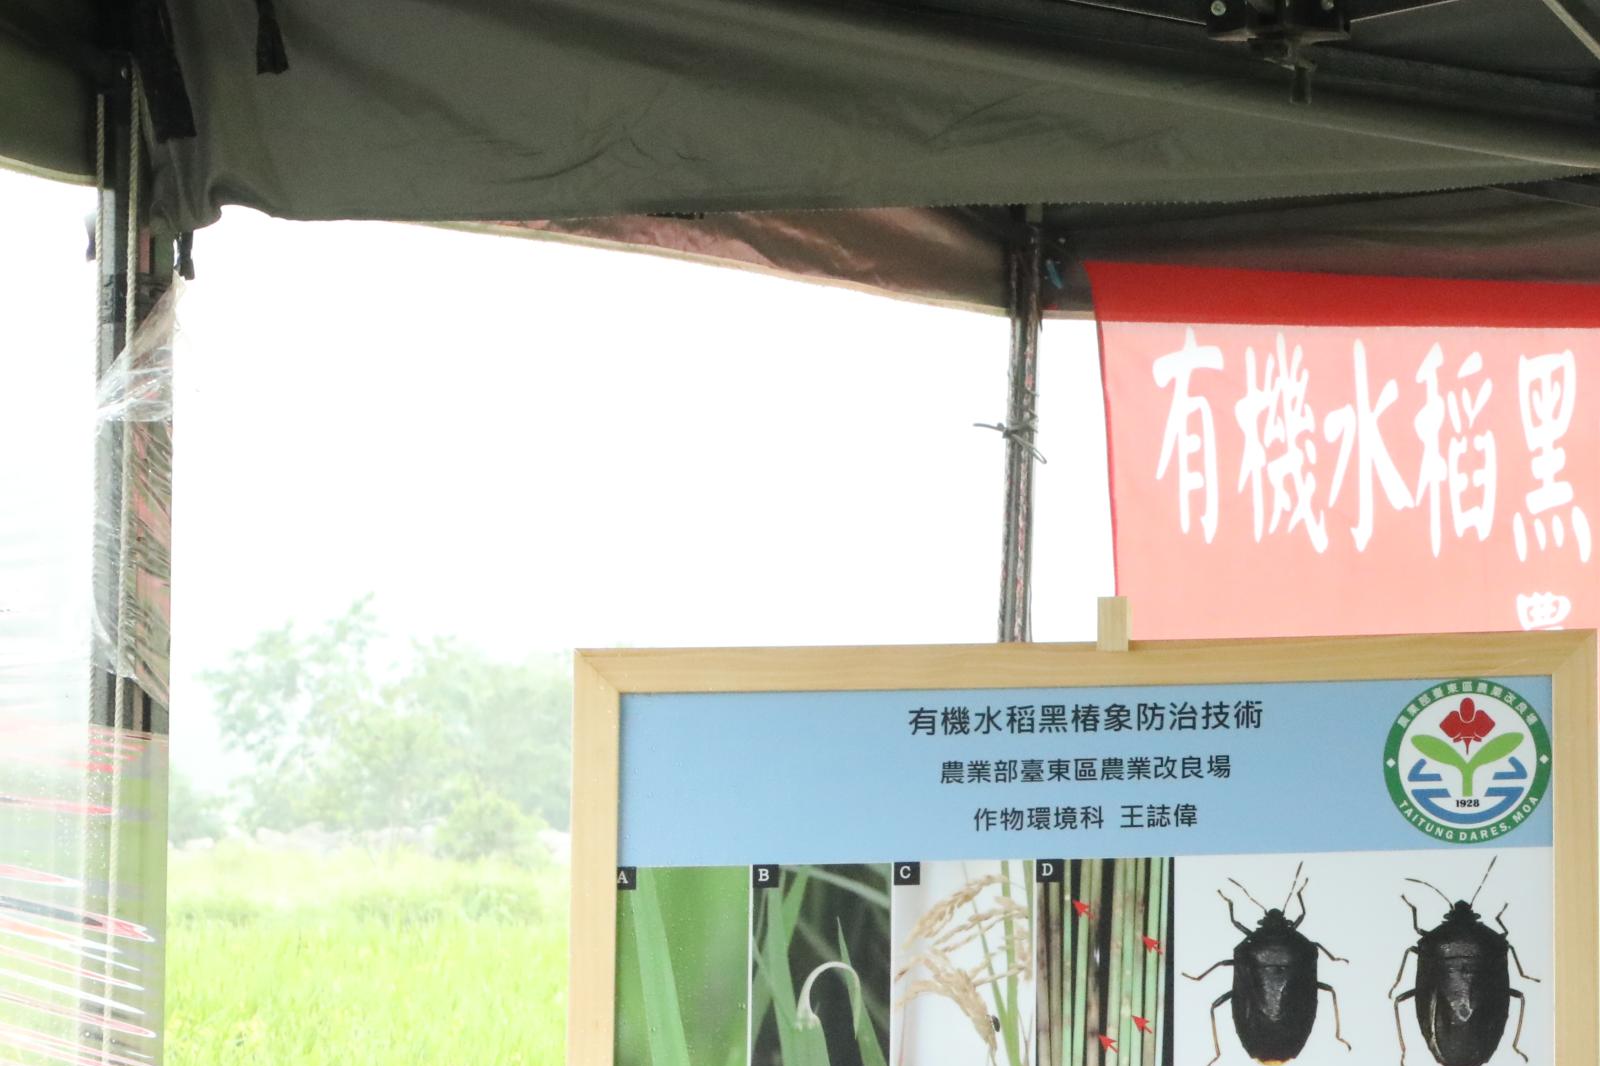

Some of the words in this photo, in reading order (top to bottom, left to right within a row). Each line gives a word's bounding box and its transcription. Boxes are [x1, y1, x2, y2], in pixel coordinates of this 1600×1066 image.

[908, 700, 1264, 736] 有機水稻黑椿象防治技術
[940, 755, 1231, 785] 農業部臺東區農業改良場
[1456, 800, 1480, 808] 1928
[973, 806, 1105, 832] 作物環境科
[1120, 804, 1199, 829] 王誌偉
[1399, 799, 1454, 840] TAITUNG
[1512, 796, 1539, 824] MOA
[758, 868, 770, 882] B
[900, 865, 912, 879] C
[1042, 863, 1054, 877] D
[617, 871, 629, 885] A
